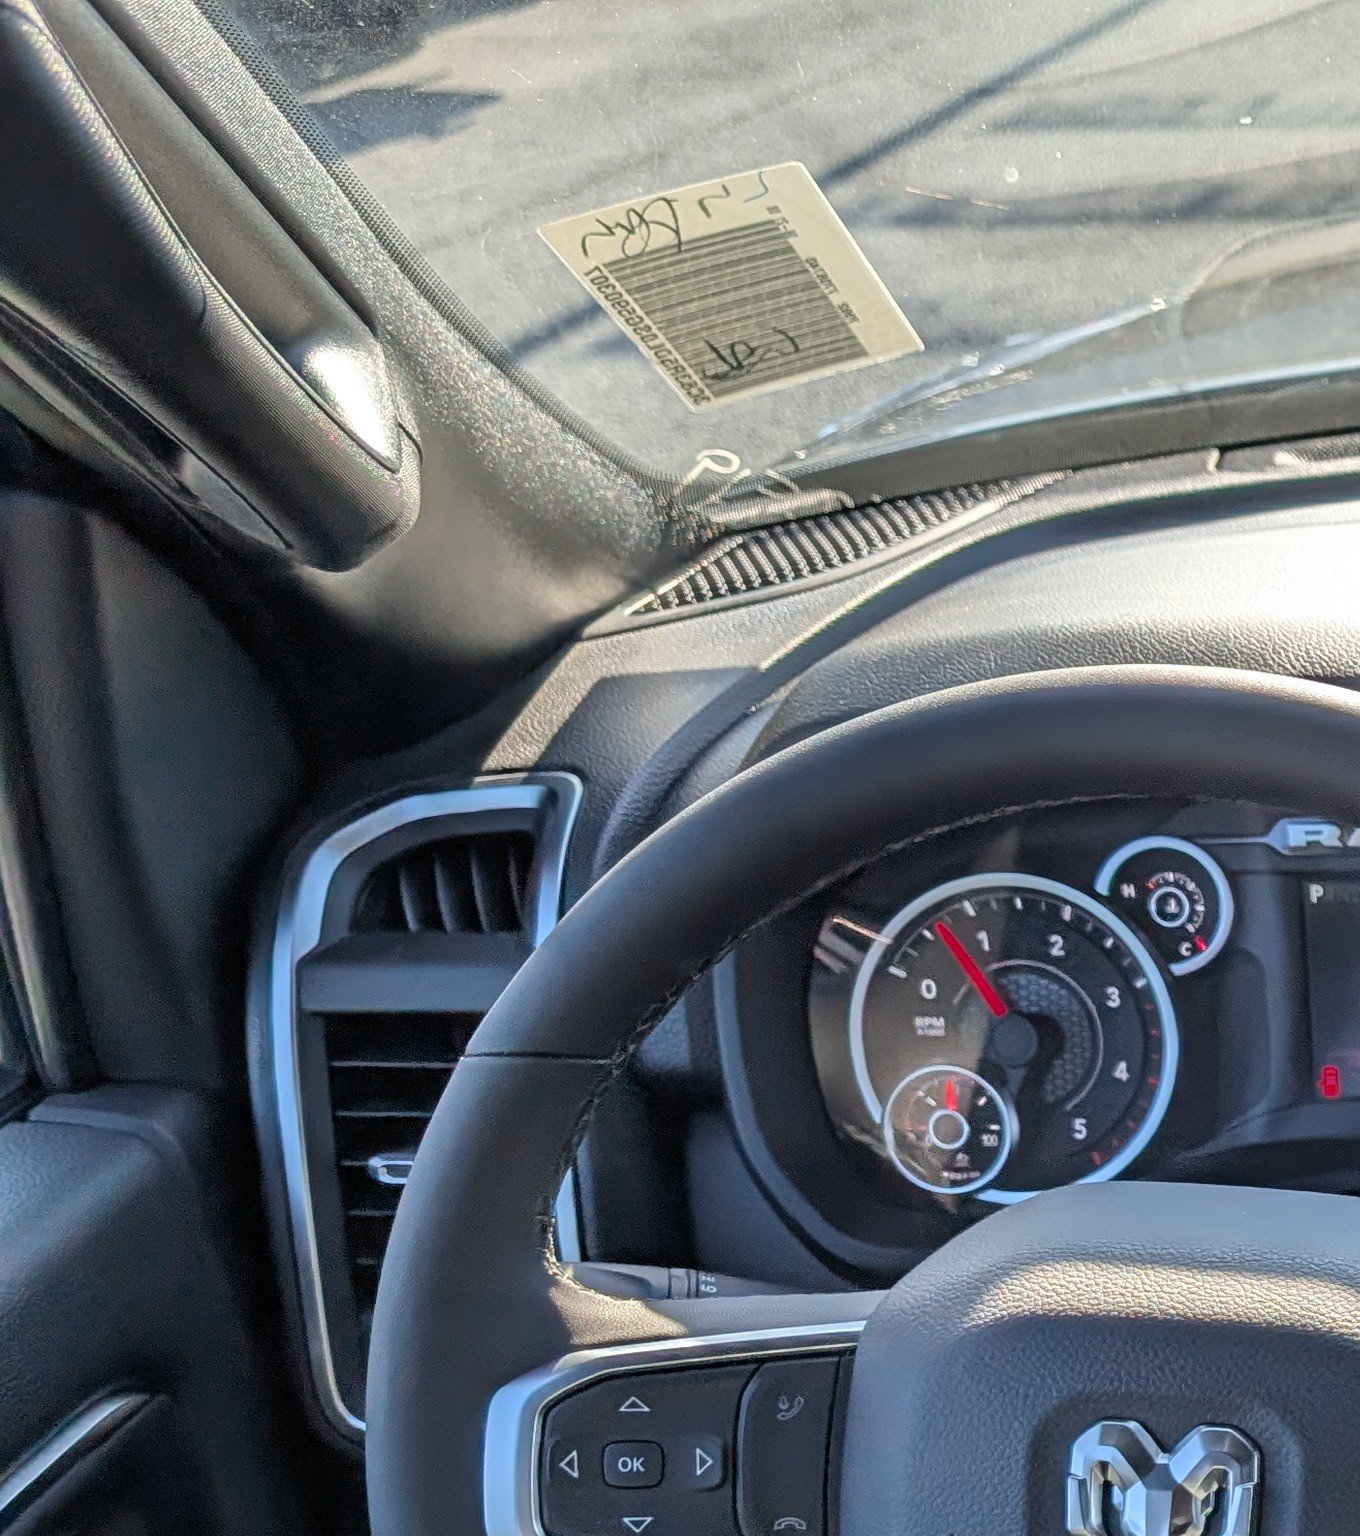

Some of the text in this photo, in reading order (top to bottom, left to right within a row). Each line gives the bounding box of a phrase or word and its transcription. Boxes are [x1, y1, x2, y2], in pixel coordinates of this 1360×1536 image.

[976, 930, 990, 952] 1
[1048, 934, 1066, 957] 2
[920, 978, 938, 1000] 0
[1105, 986, 1122, 1008] 3
[1113, 1061, 1130, 1082] 4
[1072, 1118, 1088, 1141] 5
[617, 1456, 646, 1473] OK
